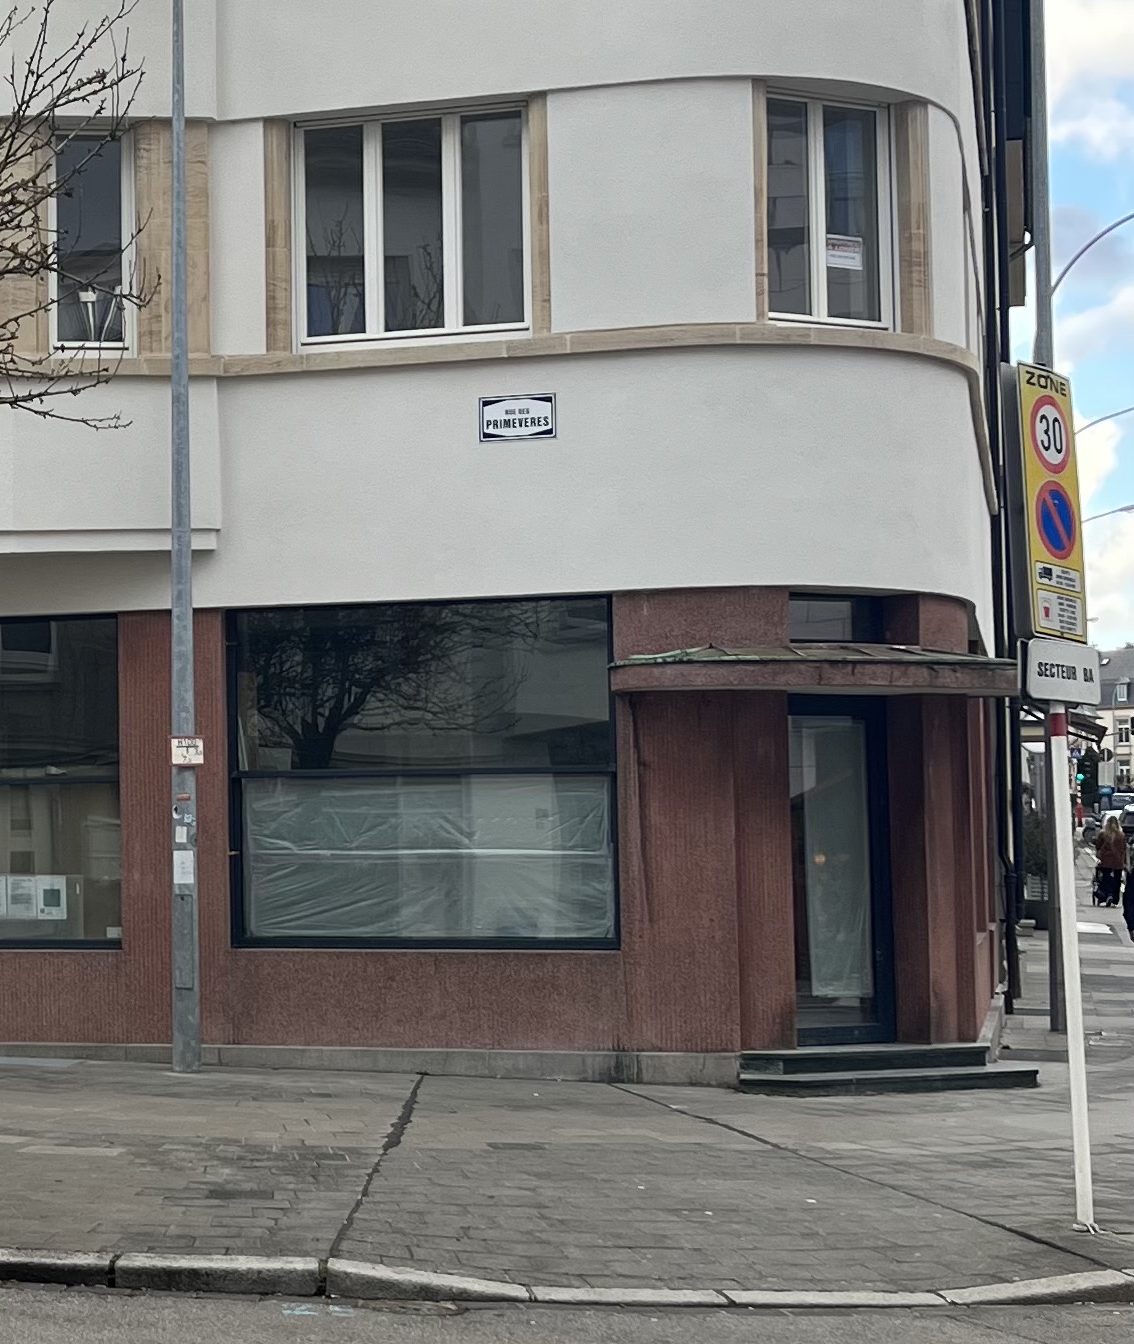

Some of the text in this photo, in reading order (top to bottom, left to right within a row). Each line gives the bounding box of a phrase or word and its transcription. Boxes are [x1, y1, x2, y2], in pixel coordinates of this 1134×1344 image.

[1025, 370, 1067, 397] ZONE
[486, 416, 550, 430] PRIMEVERES
[1039, 414, 1063, 454] 30
[1037, 661, 1078, 681] SECTEUR
